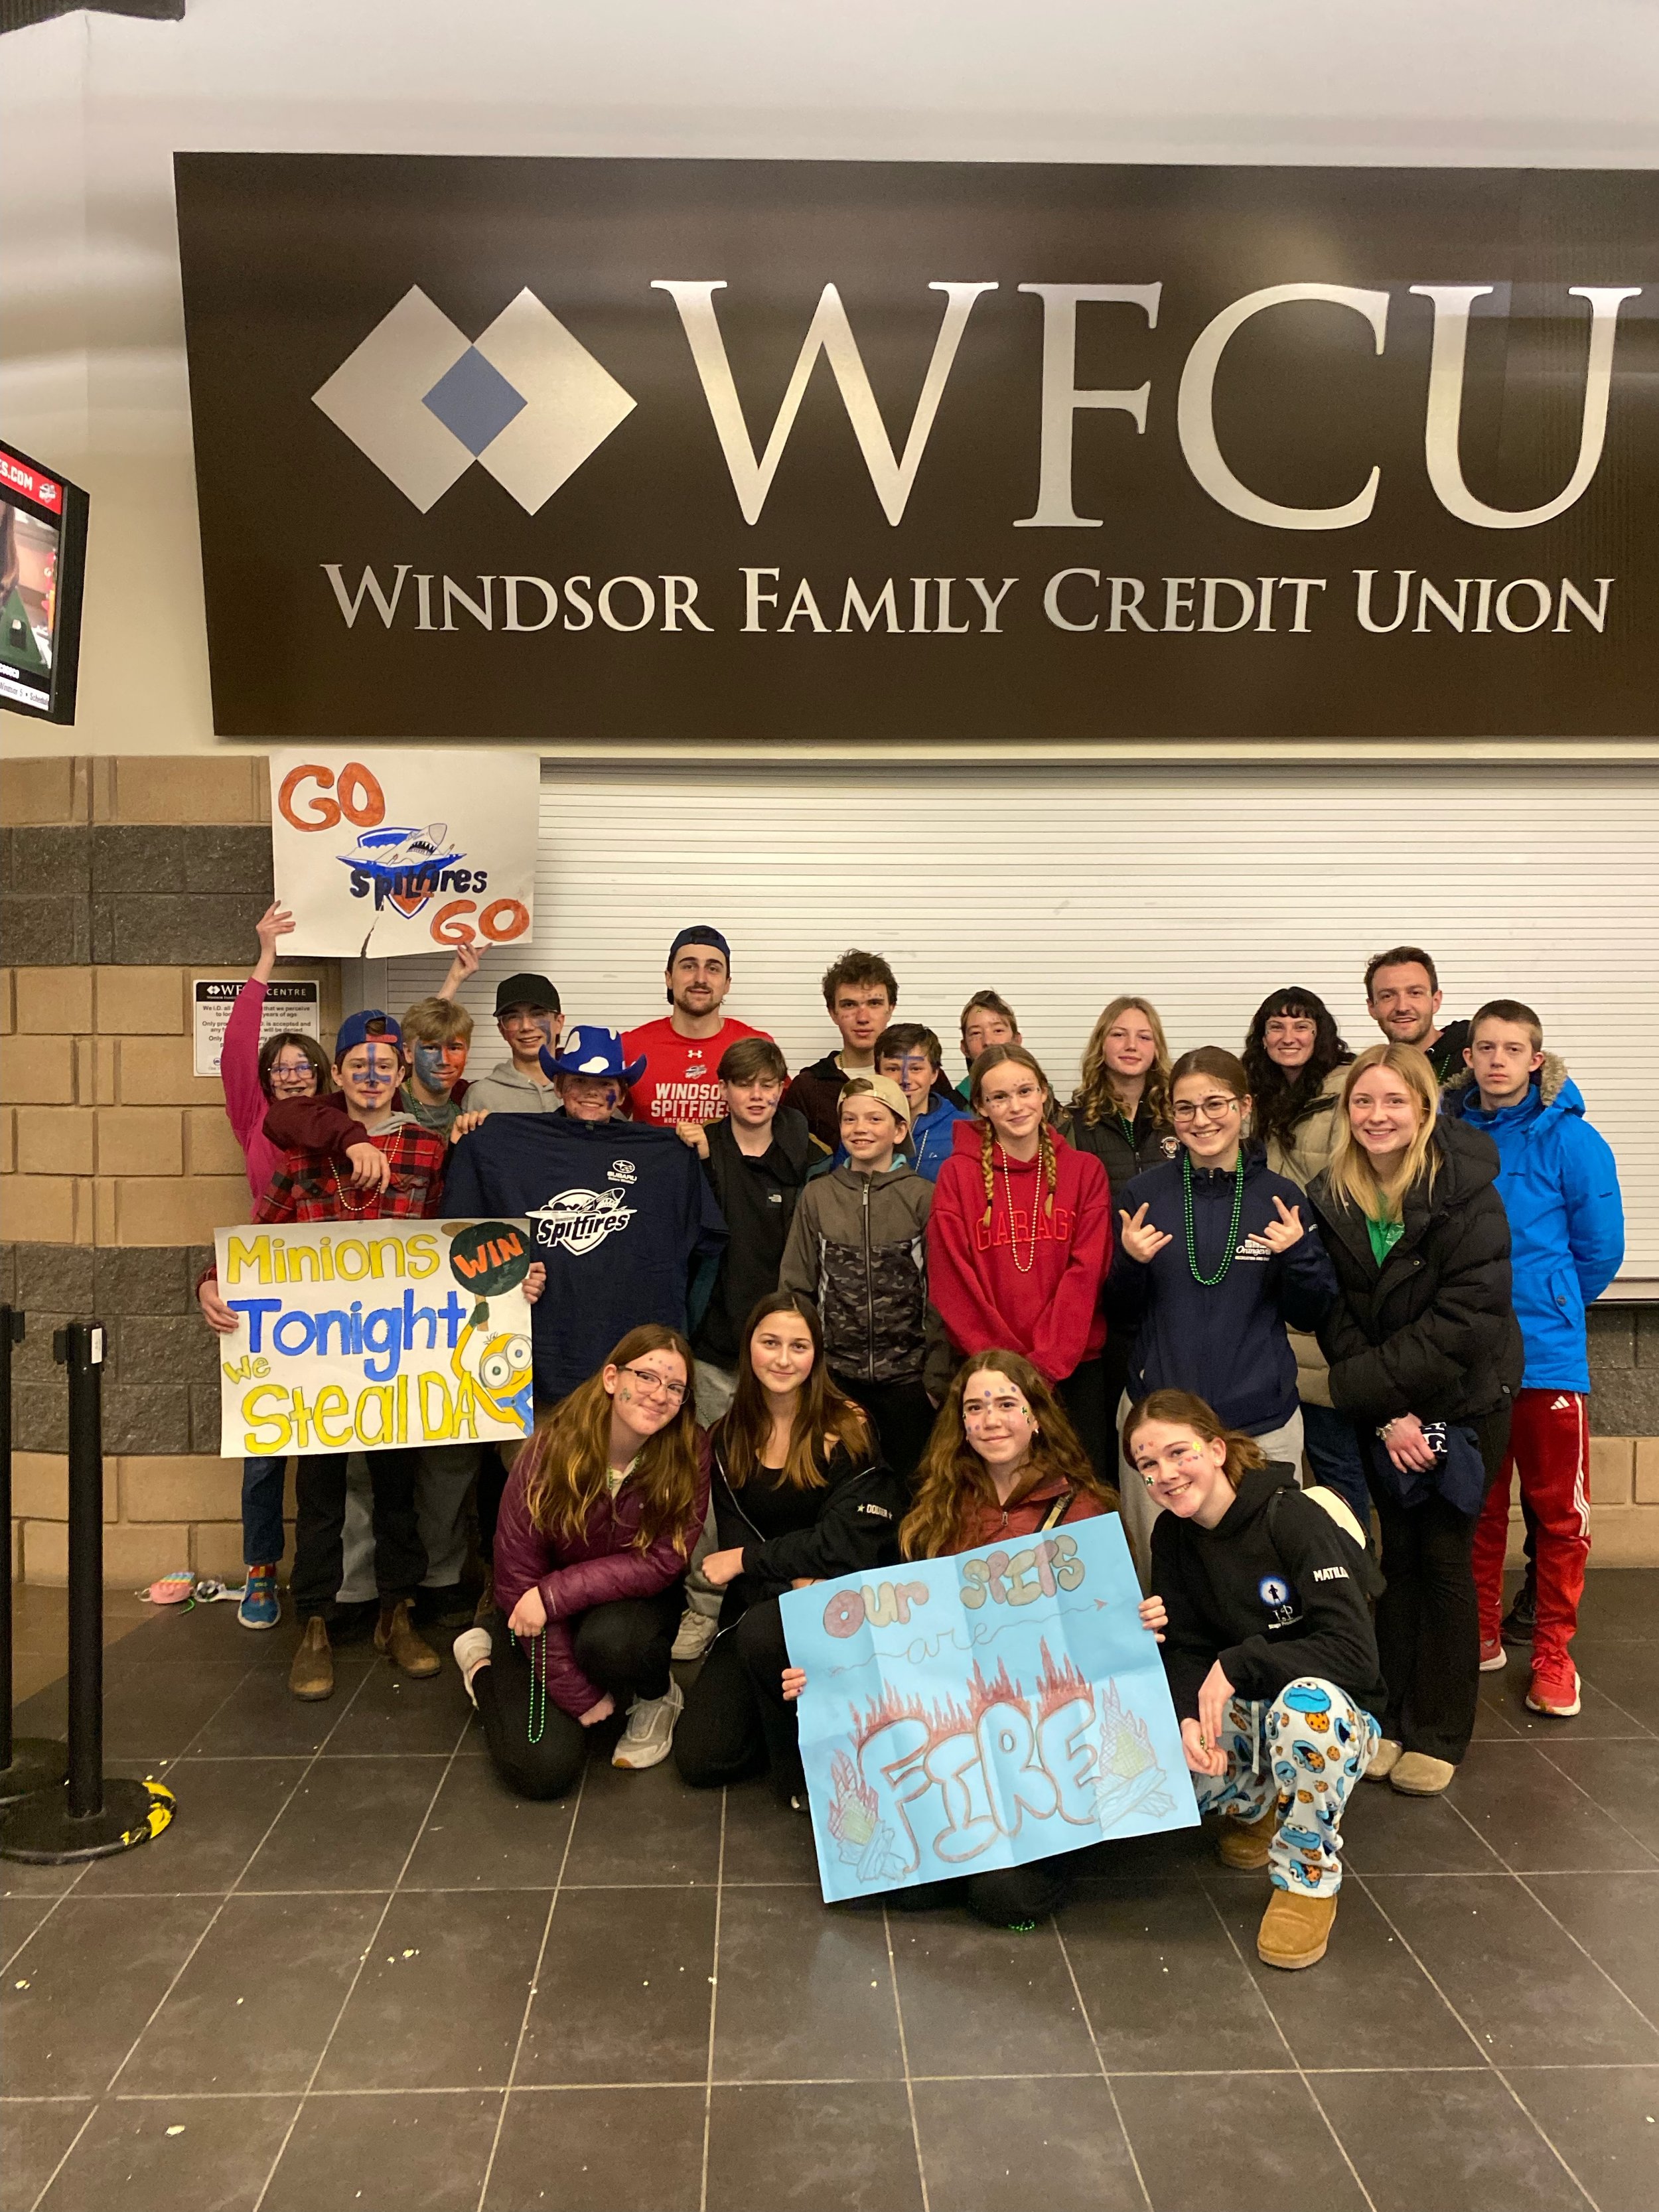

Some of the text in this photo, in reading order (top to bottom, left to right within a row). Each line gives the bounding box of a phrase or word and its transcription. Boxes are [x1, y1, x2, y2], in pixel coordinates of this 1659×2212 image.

[650, 279, 1642, 530] WFCU
[0, 459, 33, 491] S.COM
[321, 564, 1616, 633] WINDSOR FAMILY CREDIT UNION
[278, 762, 386, 832] GO
[430, 899, 530, 946] GO
[221, 985, 245, 995] WF
[656, 1083, 721, 1100] WINDSO
[607, 1171, 637, 1181] SUBARU
[537, 1213, 630, 1246] Spitfires
[975, 1208, 1076, 1251] GARAG
[227, 1234, 440, 1284] Minions
[453, 1232, 524, 1279] WIN
[227, 1288, 467, 1382] Tonight
[241, 1374, 409, 1455] Steal
[1313, 1566, 1350, 1582] MATILD
[857, 1696, 1103, 1874] FIRE
